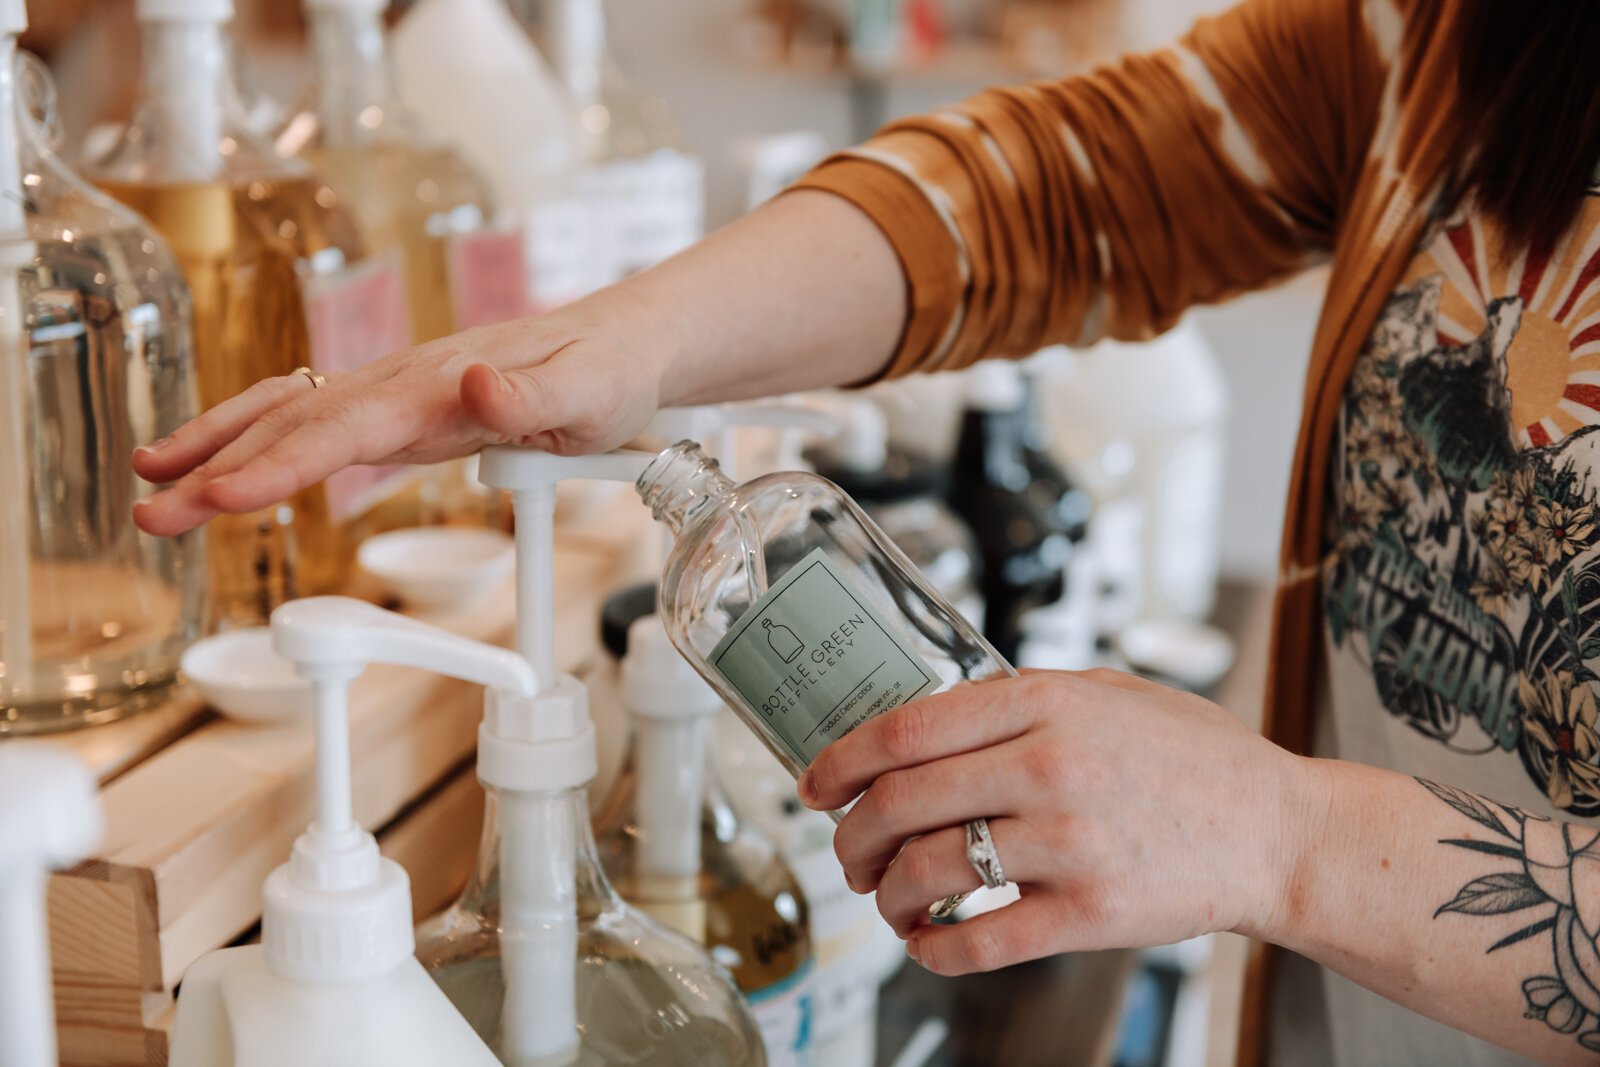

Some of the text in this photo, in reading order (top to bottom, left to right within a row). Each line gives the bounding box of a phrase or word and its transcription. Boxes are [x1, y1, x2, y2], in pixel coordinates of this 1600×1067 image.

[762, 613, 864, 716] BOTTLE GREEN
[780, 639, 854, 714] REFILLERY
[819, 681, 875, 736] Product Description
[865, 697, 883, 715] usage
[882, 690, 894, 699] info
[893, 681, 901, 690] at
